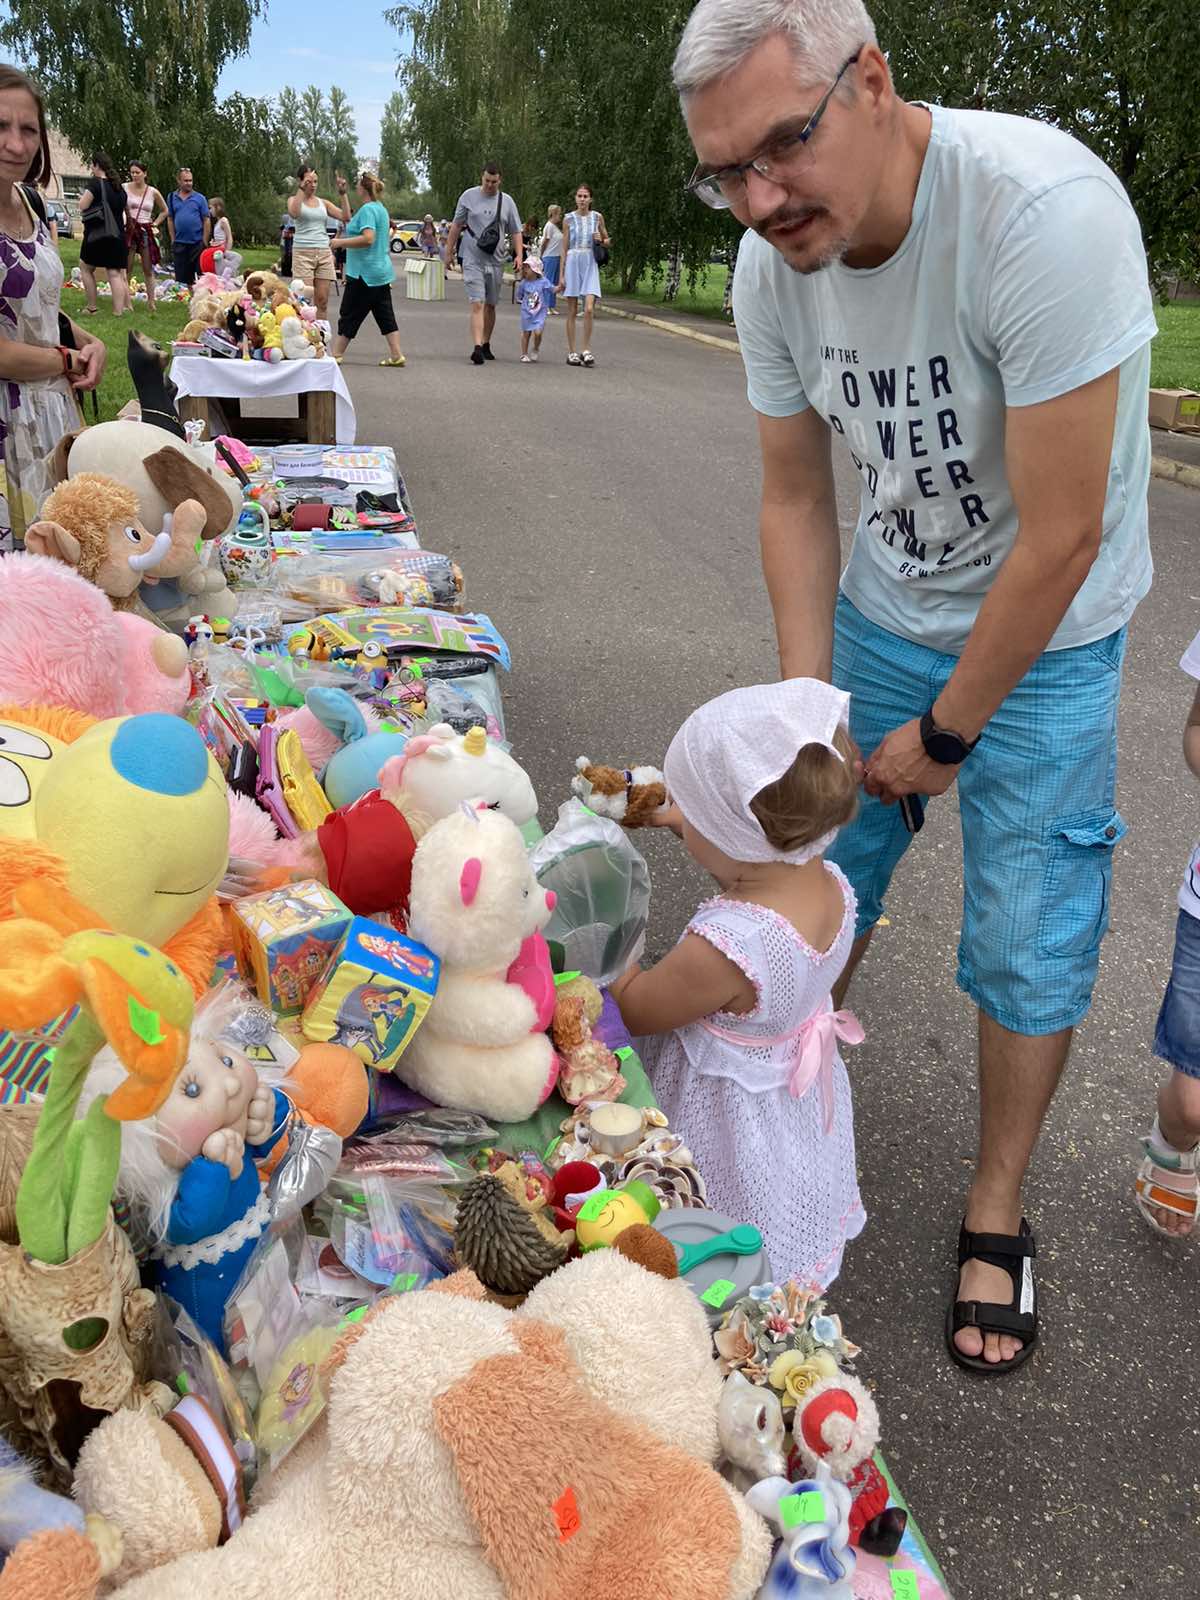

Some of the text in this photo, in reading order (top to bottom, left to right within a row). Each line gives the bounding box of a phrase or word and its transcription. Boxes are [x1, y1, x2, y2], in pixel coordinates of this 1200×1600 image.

[821, 345, 859, 364] AY THE
[899, 562, 916, 577] BE
